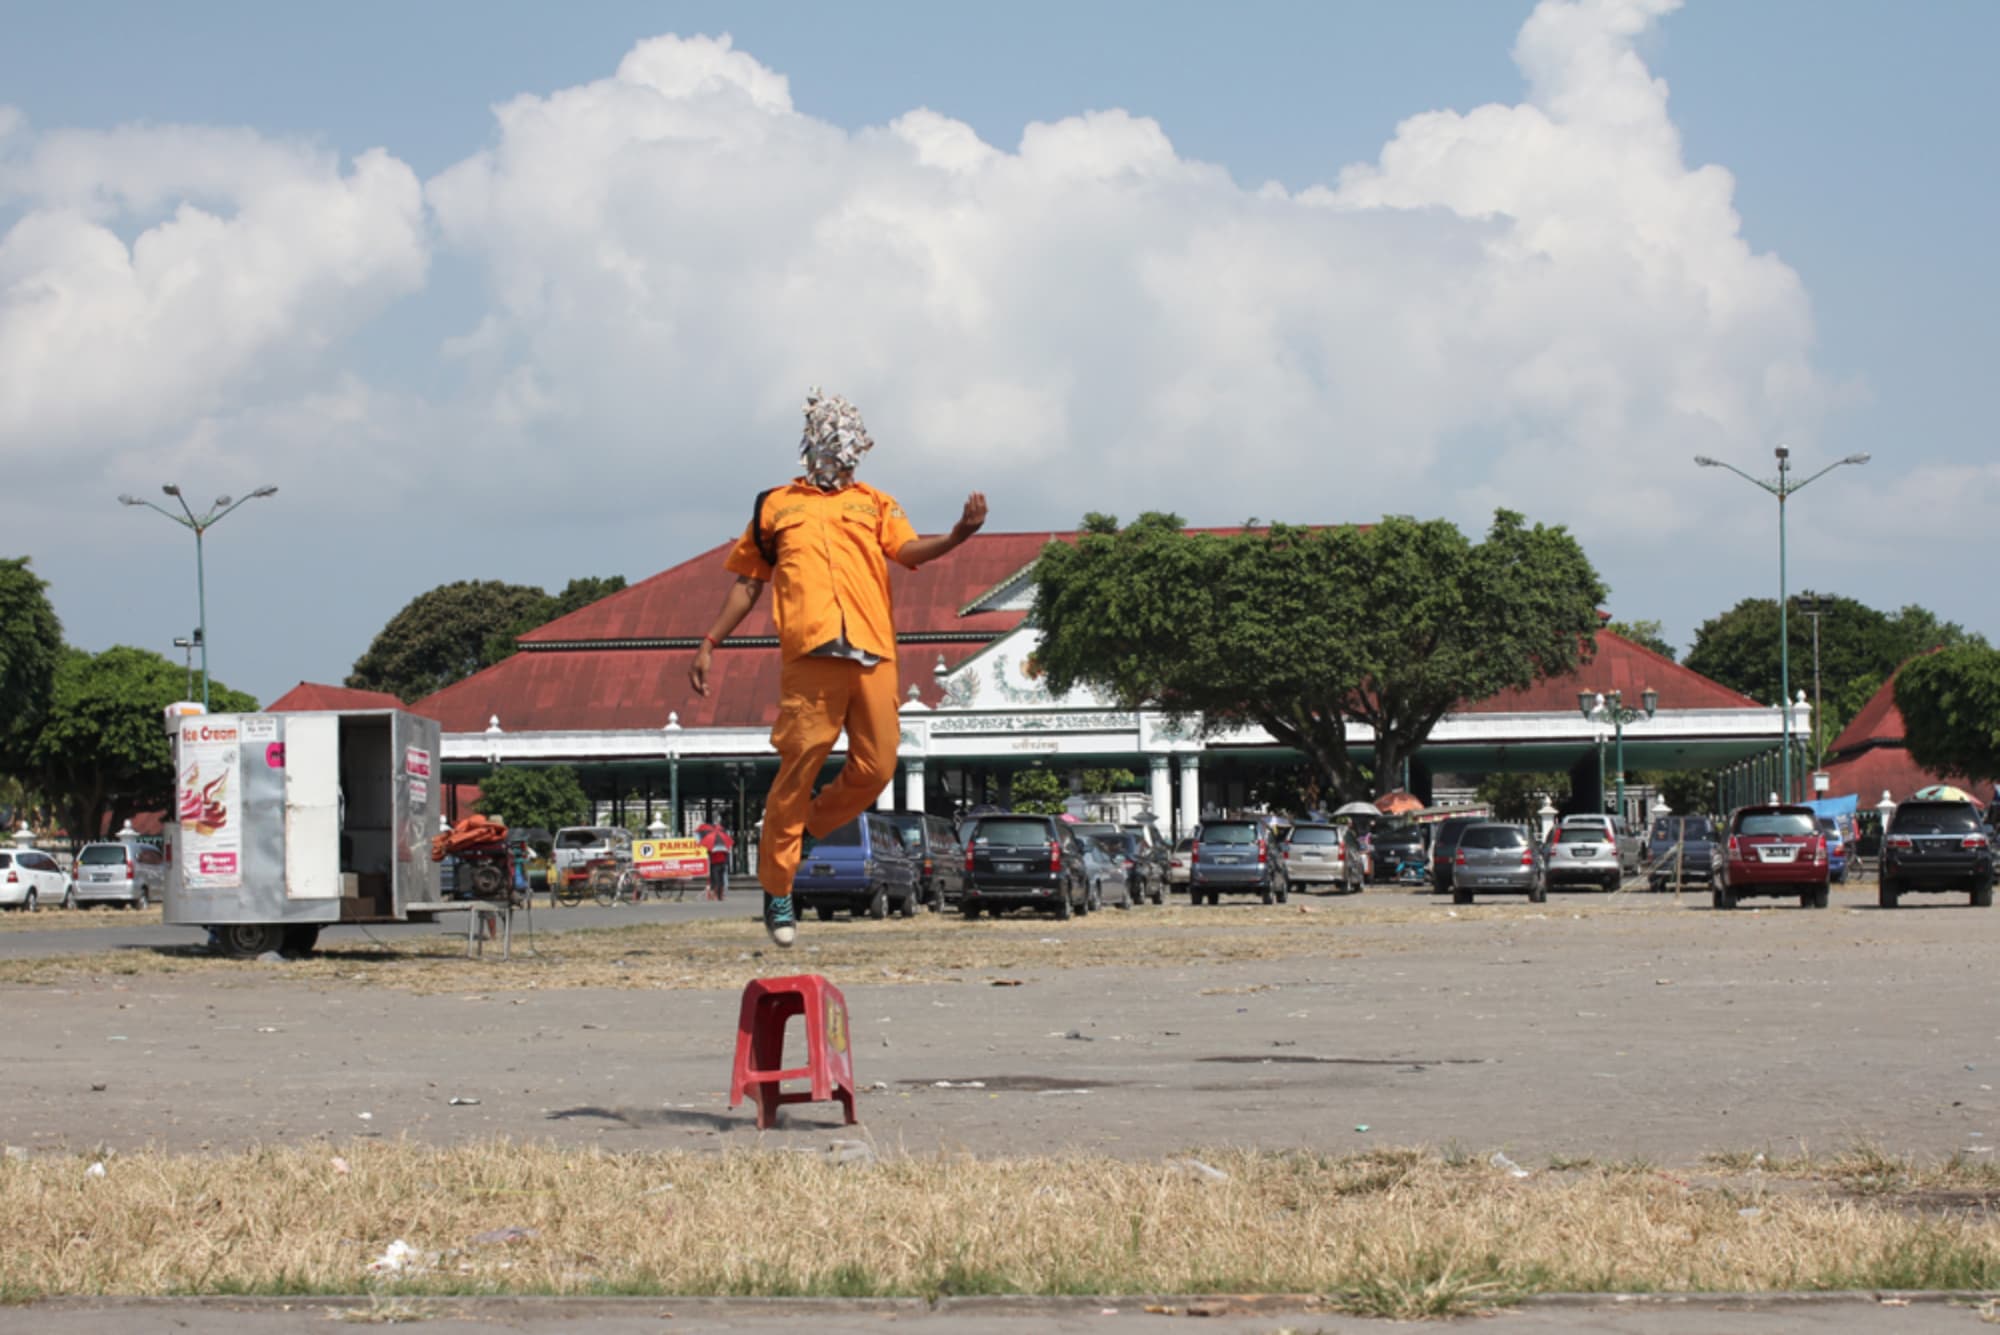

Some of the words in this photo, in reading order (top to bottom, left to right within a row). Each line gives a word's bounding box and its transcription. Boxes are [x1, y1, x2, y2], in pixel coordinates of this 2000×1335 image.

[182, 728, 198, 741] Ice
[201, 726, 237, 741] Cream
[643, 846, 651, 856] P
